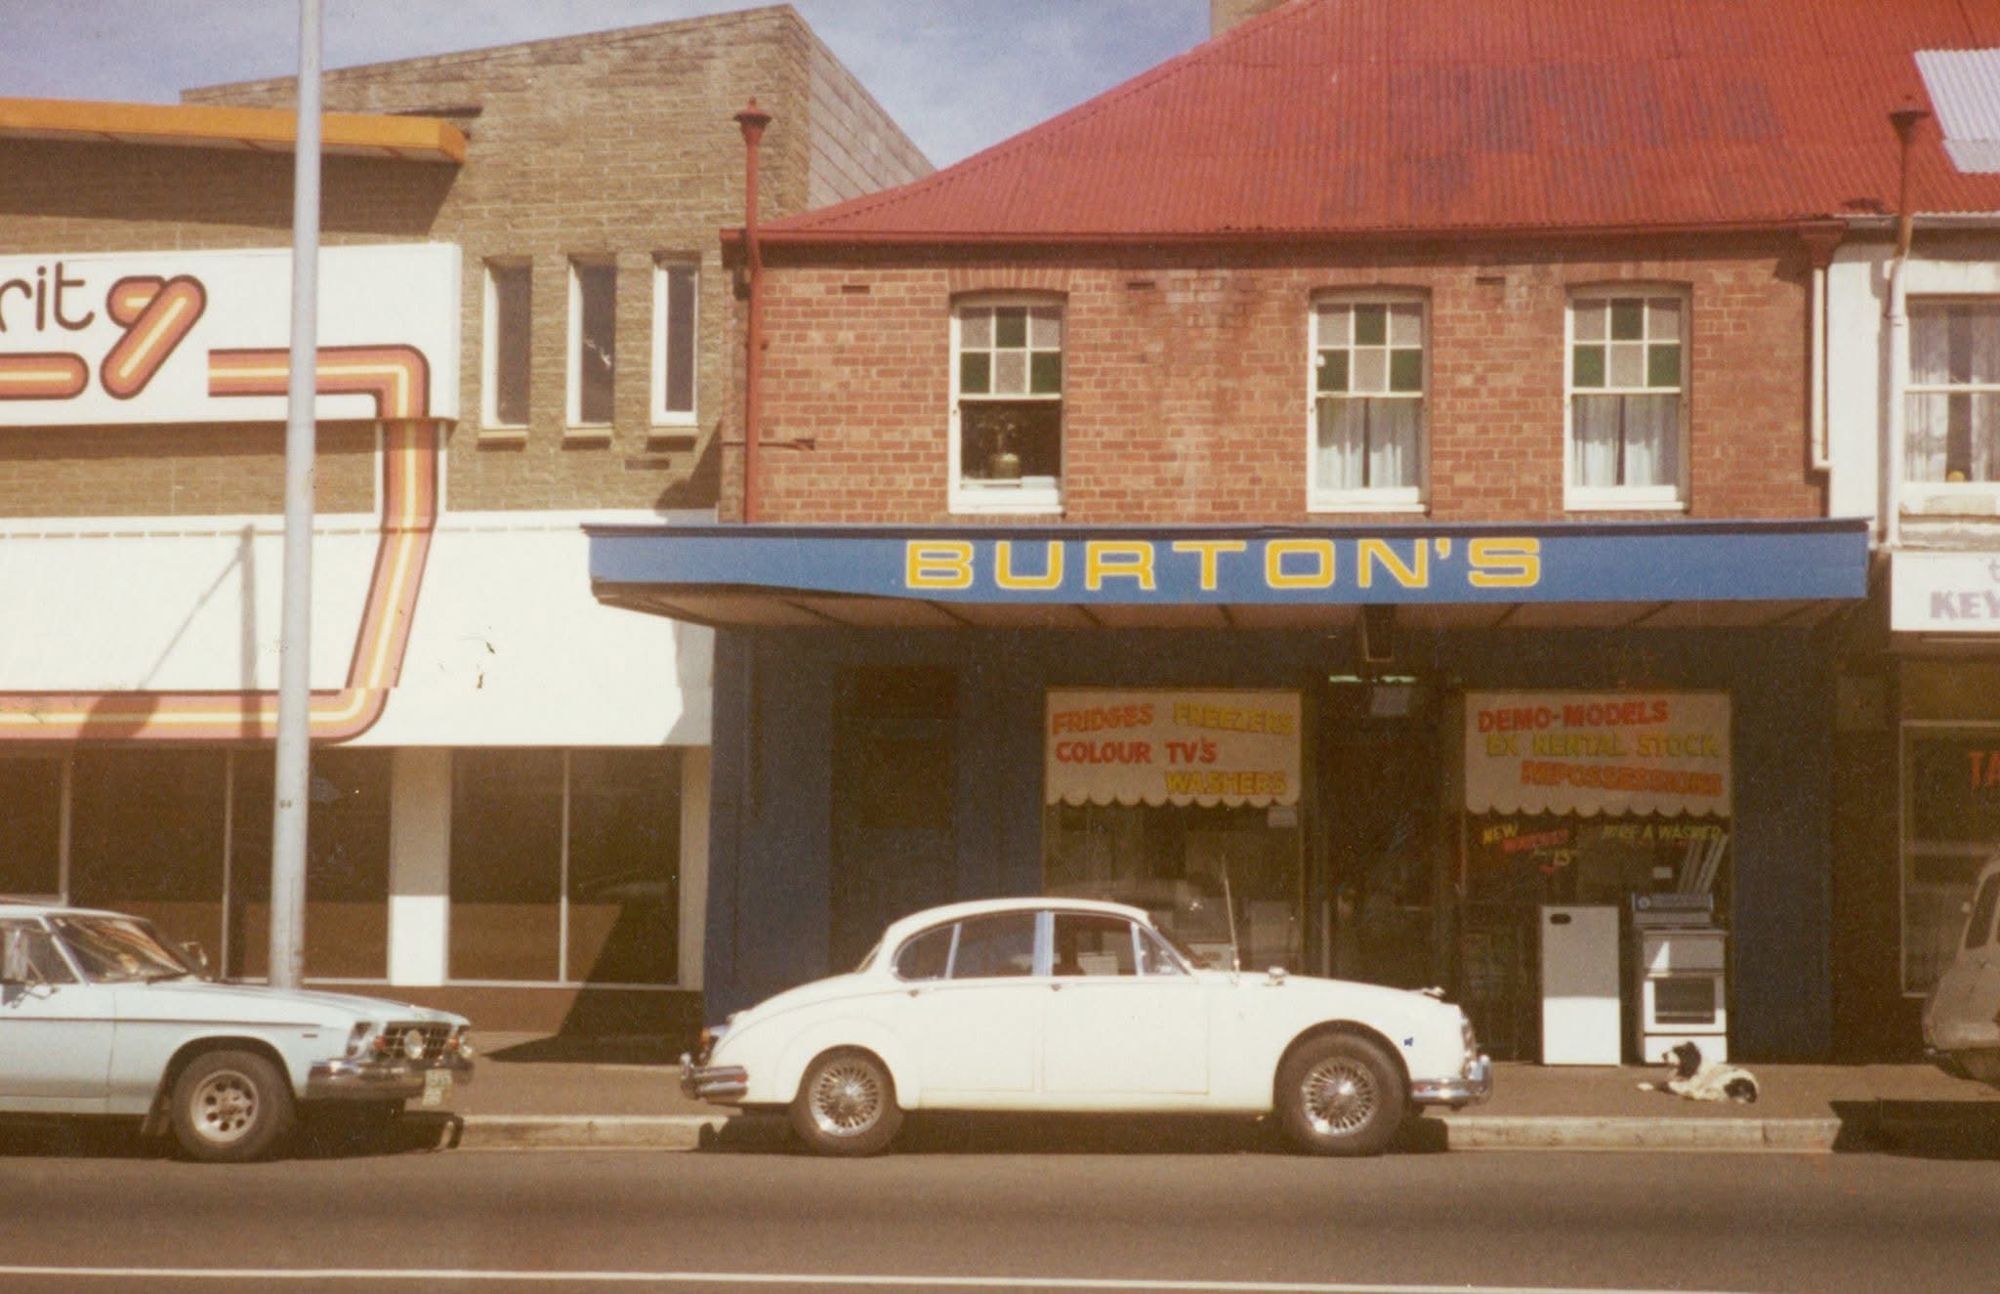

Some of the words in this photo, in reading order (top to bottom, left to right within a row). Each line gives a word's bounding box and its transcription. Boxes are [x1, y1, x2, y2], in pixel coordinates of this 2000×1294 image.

[904, 537, 1542, 591] BURTON'S
[1053, 703, 1154, 735] FRIDGES
[1172, 703, 1295, 737] FREEZERS
[1477, 701, 1669, 733] DEMO-MODELS
[1055, 741, 1152, 765] COLOUR
[1486, 733, 1521, 757] EX
[1532, 733, 1628, 757] RENTAL
[1636, 733, 1721, 757] STOCK
[1165, 770, 1287, 796] WASHERS
